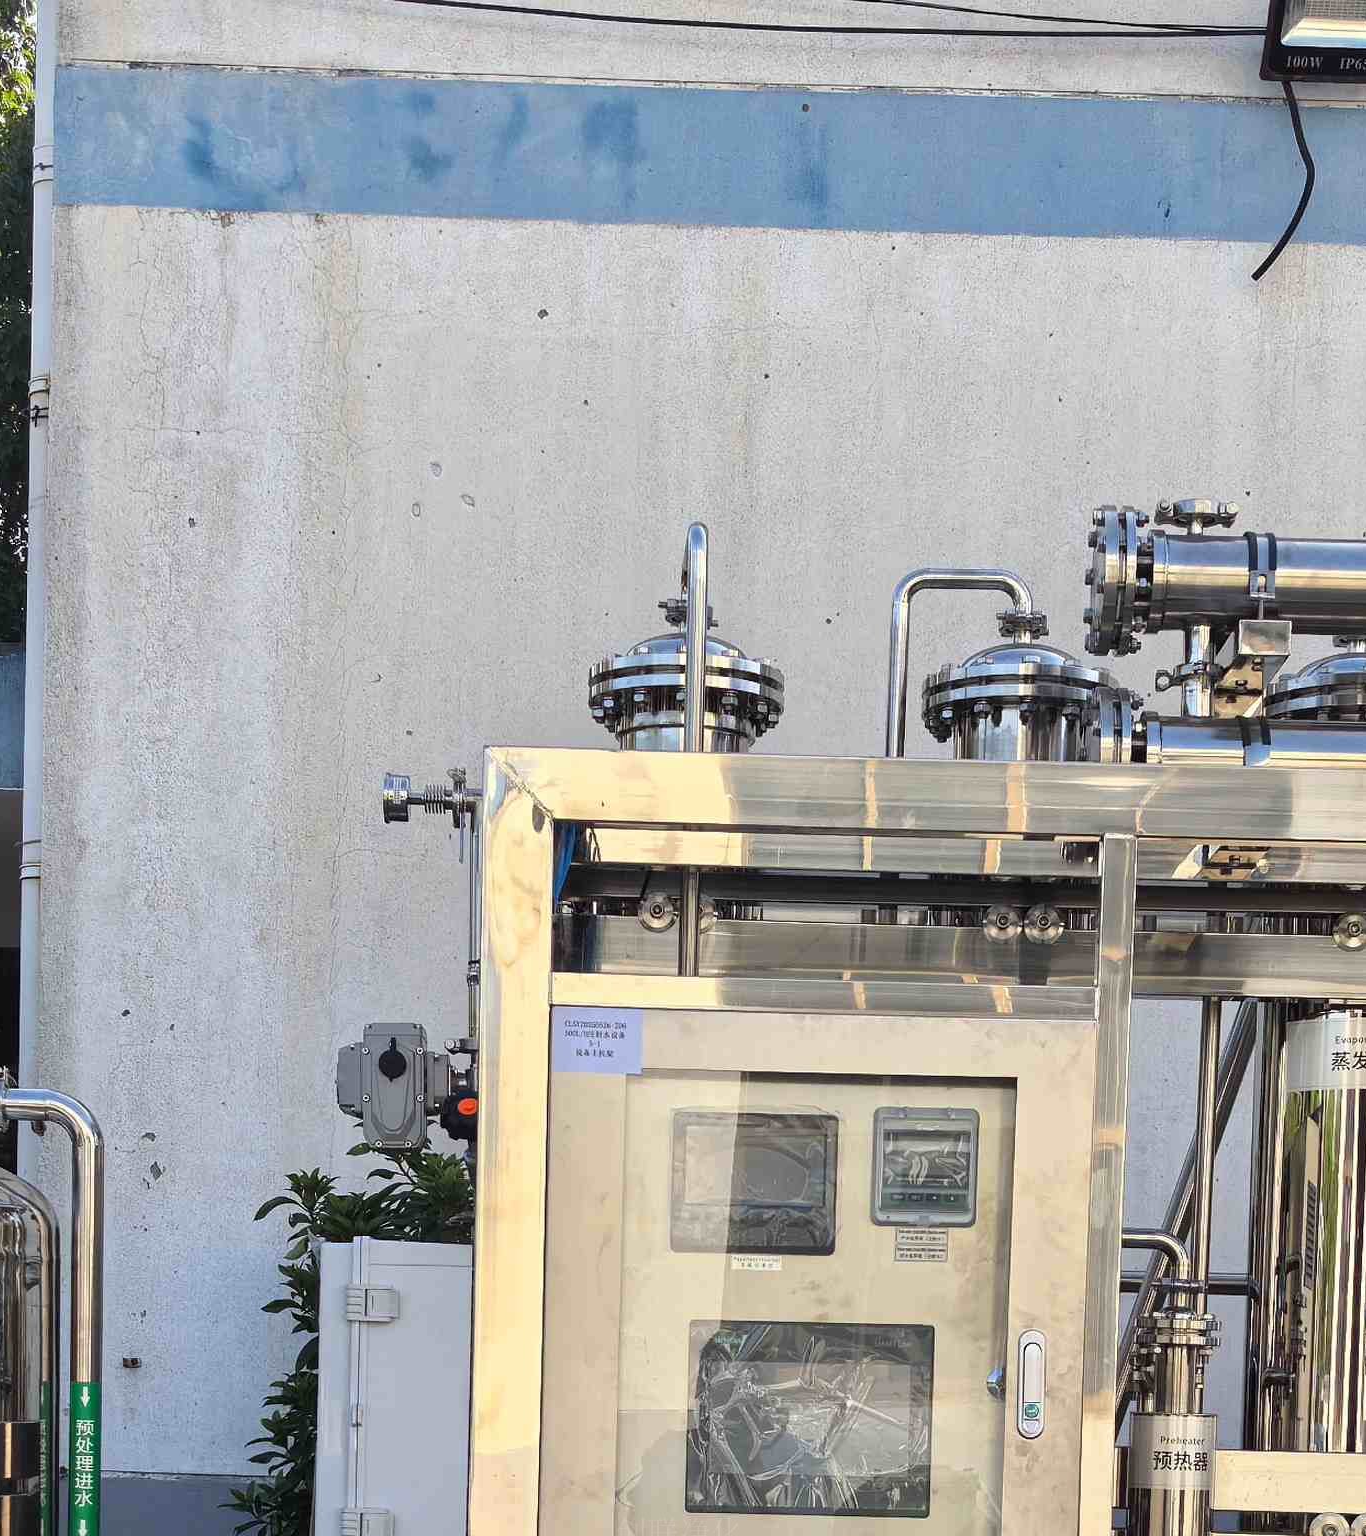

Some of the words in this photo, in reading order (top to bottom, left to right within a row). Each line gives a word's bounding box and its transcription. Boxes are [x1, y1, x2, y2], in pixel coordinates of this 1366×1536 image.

[1286, 56, 1323, 70] 100W
[74, 1419, 96, 1507] 预处理进水
[1153, 1450, 1208, 1471] 预热器
